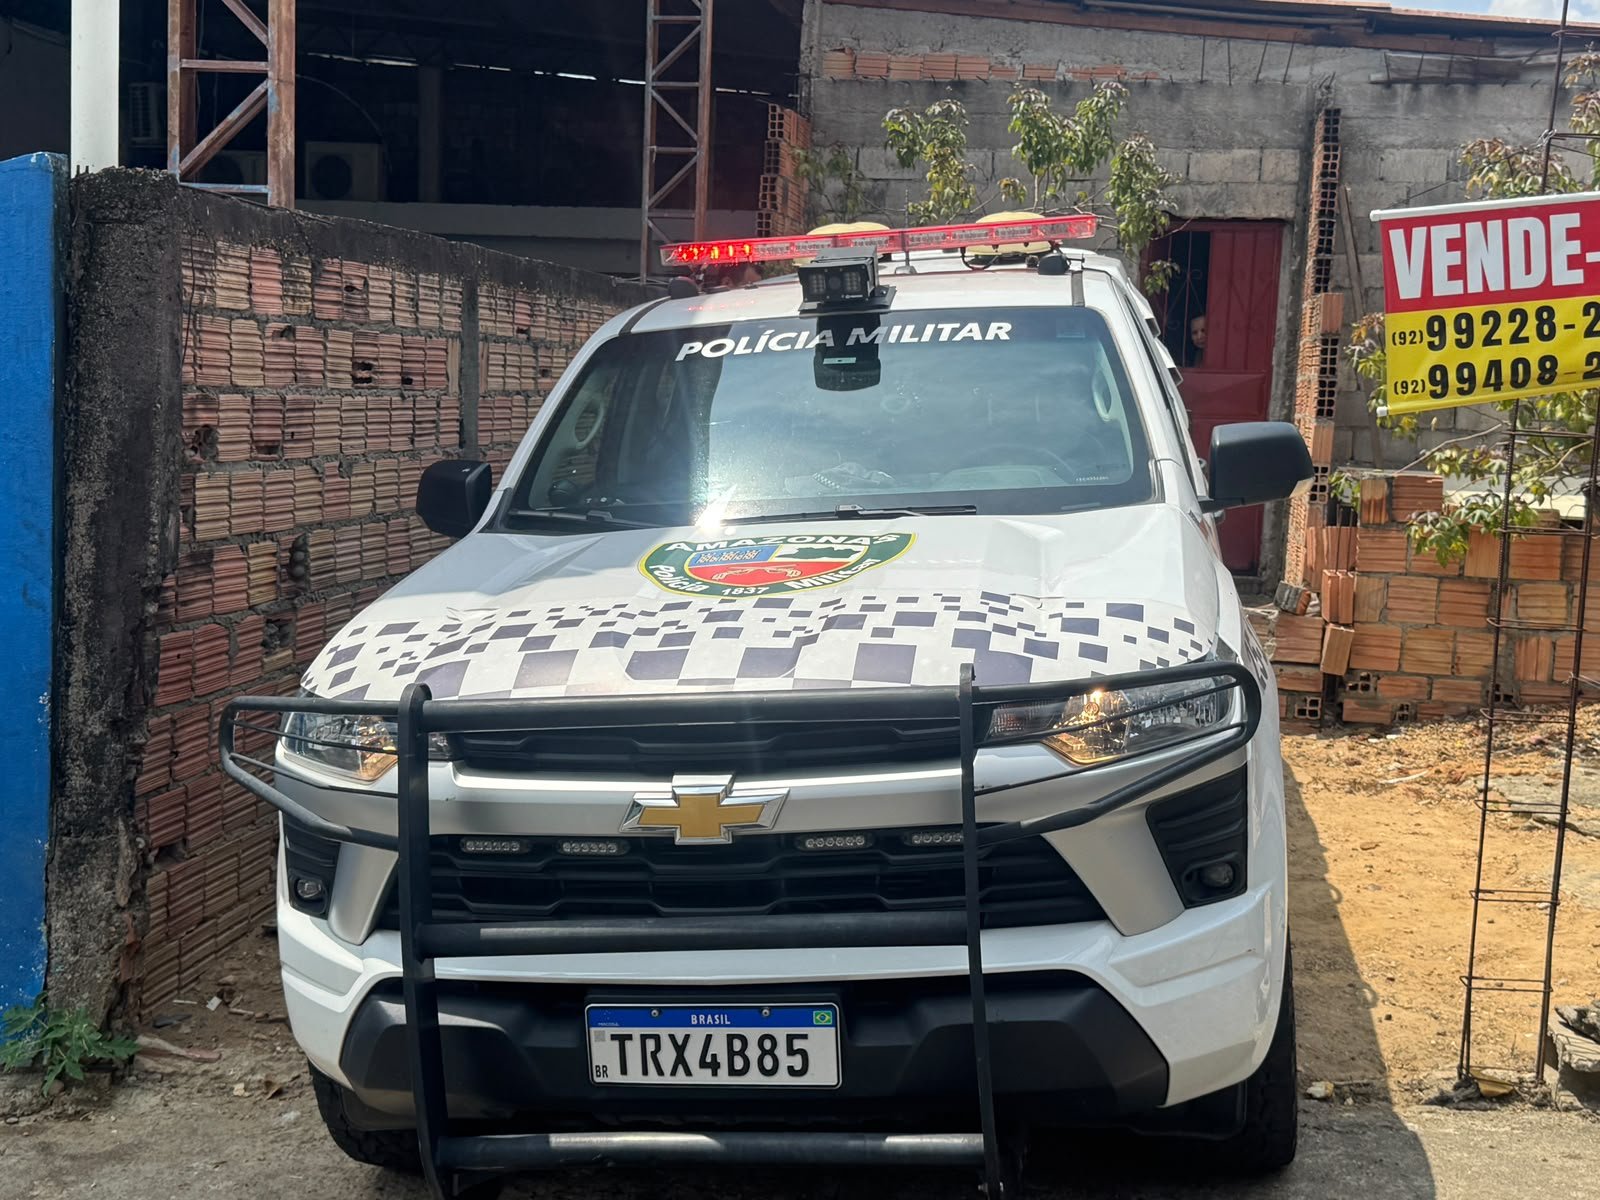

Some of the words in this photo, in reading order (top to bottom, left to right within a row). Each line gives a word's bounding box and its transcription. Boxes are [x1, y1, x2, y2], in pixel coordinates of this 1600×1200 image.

[675, 329, 834, 361] POLÍCIA
[846, 322, 1012, 347] MILITAR
[1391, 330, 1424, 346] (92)
[1393, 379, 1426, 396] (92)
[665, 534, 900, 551] AMAZONAS
[783, 558, 881, 589] Militar
[722, 586, 769, 596] 1837
[691, 1014, 731, 1025] BRASIL
[610, 1033, 809, 1077] TRX4B85
[595, 1065, 608, 1078] BR
